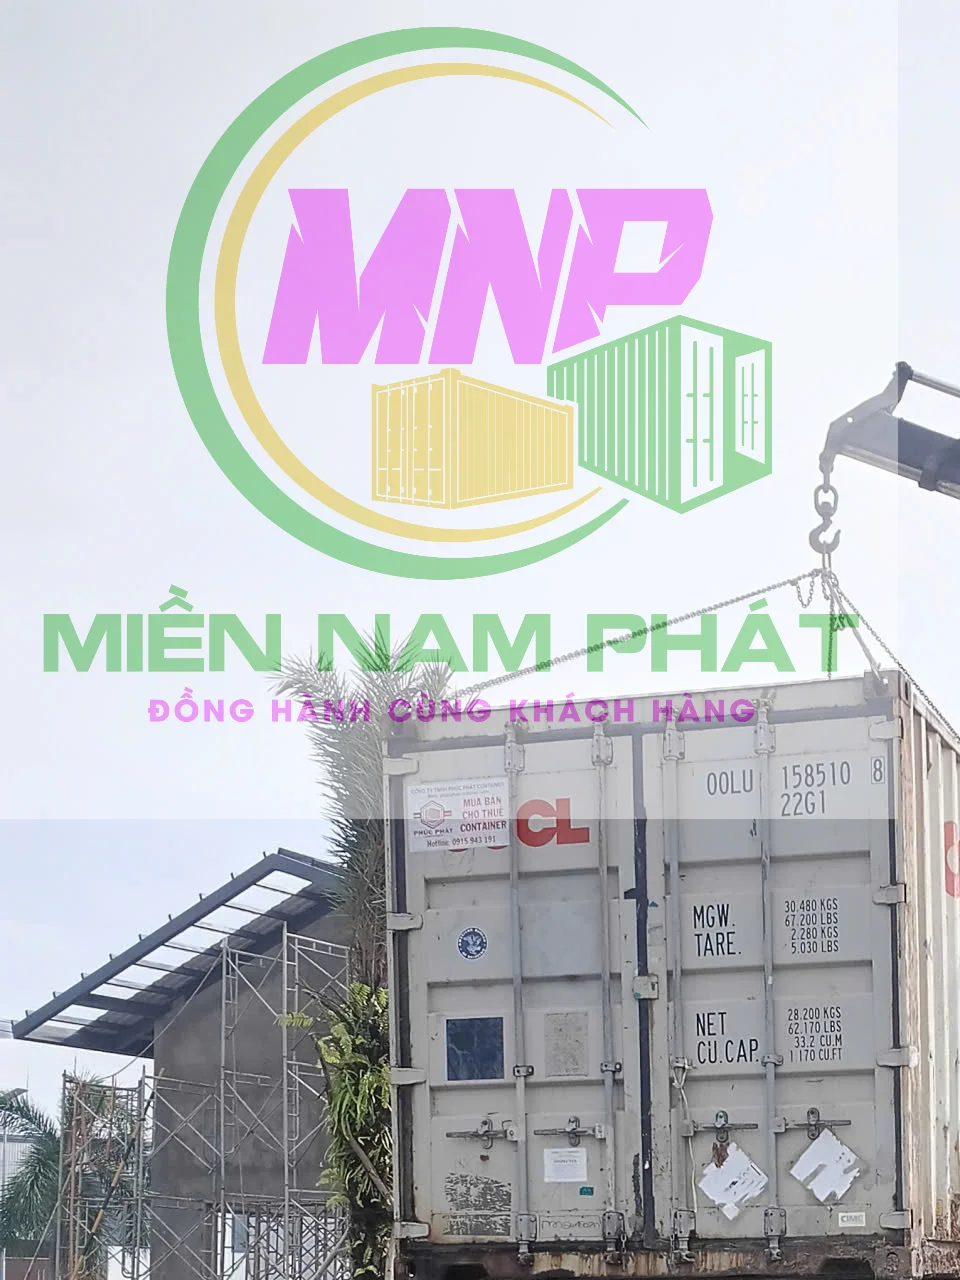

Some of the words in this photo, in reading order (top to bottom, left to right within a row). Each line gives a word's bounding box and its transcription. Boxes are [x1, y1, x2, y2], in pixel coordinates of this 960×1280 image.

[782, 761, 851, 790] 158510
[873, 758, 883, 782] 8
[463, 797, 482, 808] MUA
[780, 790, 826, 817] 22G1
[462, 809, 480, 820] CHO
[460, 821, 507, 833] CONTAINER
[451, 837, 469, 846] 0915
[469, 836, 483, 844] 943
[484, 835, 496, 844] 191
[784, 898, 817, 912] 30.480
[820, 898, 838, 911] KGS
[693, 904, 736, 929] MGW.
[784, 913, 817, 927] 67.200
[821, 912, 839, 925] LBS
[791, 927, 817, 940] 2.280
[821, 926, 839, 939] KGS
[695, 931, 742, 957] TARE.
[791, 941, 818, 954] 5.030
[821, 940, 839, 953] LBS
[788, 1008, 820, 1021] 28.200
[823, 1006, 841, 1019] KGS
[696, 1012, 727, 1036] NET
[788, 1021, 820, 1035] 62.170
[824, 1020, 842, 1033] LBS
[794, 1036, 815, 1048] 33.2
[820, 1034, 842, 1047] CU.M
[790, 1049, 816, 1062] 1.170
[818, 1048, 842, 1061] CU.FT
